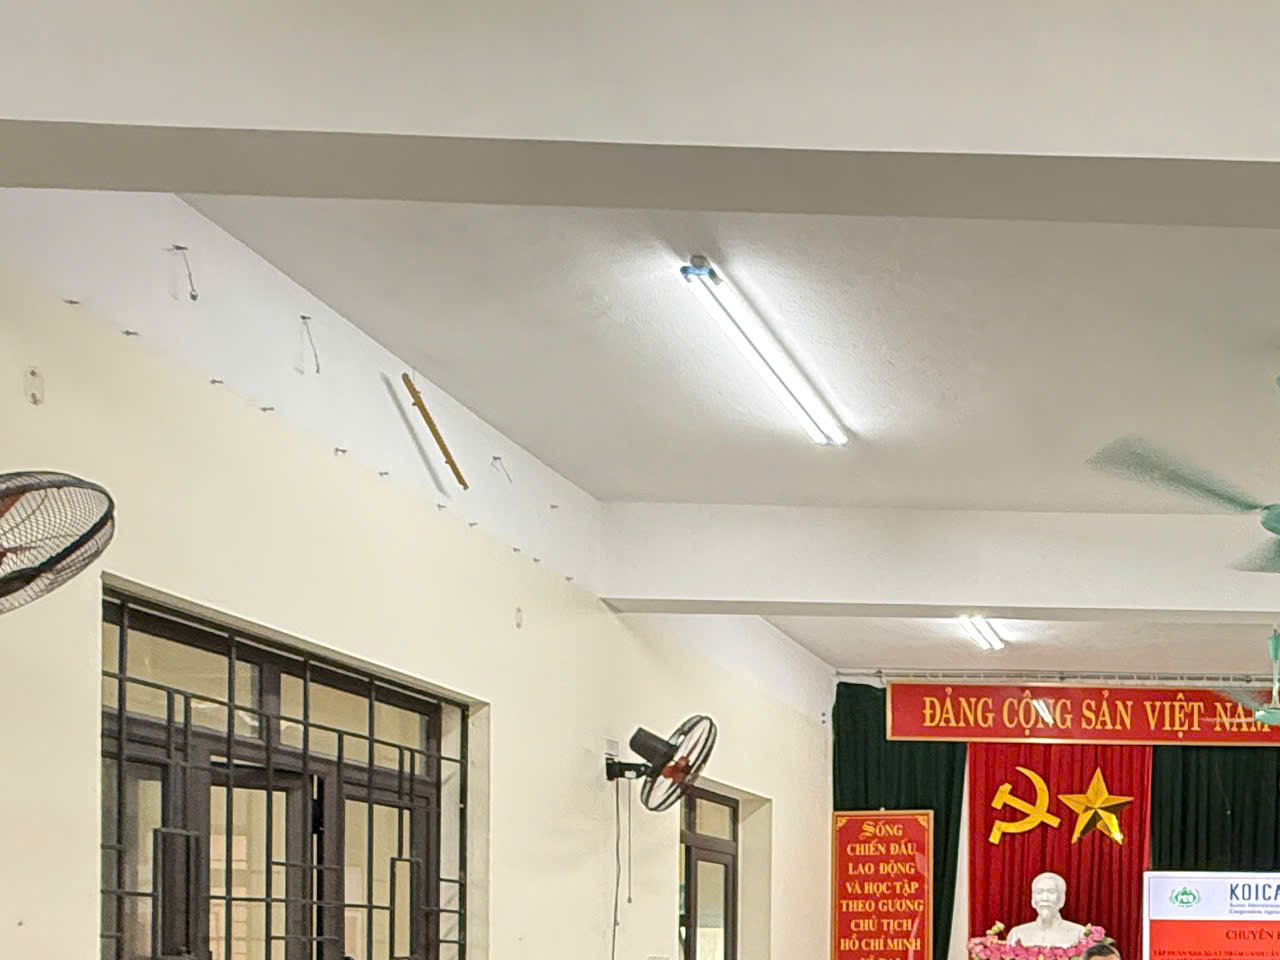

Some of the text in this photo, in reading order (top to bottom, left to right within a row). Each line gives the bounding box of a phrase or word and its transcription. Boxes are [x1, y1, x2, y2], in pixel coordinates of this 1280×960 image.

[922, 687, 994, 727] ĐẢNG
[1081, 689, 1134, 730] SẢN
[1143, 692, 1205, 739] VIỆT
[859, 820, 904, 840] SỐNG
[847, 839, 916, 856] CHIẾN ĐẤU
[848, 859, 915, 878] LAO ĐỘNG
[846, 878, 919, 897] VÀ HỌC TẬP
[840, 899, 875, 912] THEO
[850, 914, 912, 934] CHỦ TỊCH
[840, 933, 921, 951] HỒ CHÍ MINH
[1225, 928, 1274, 940] CHUYÊN
